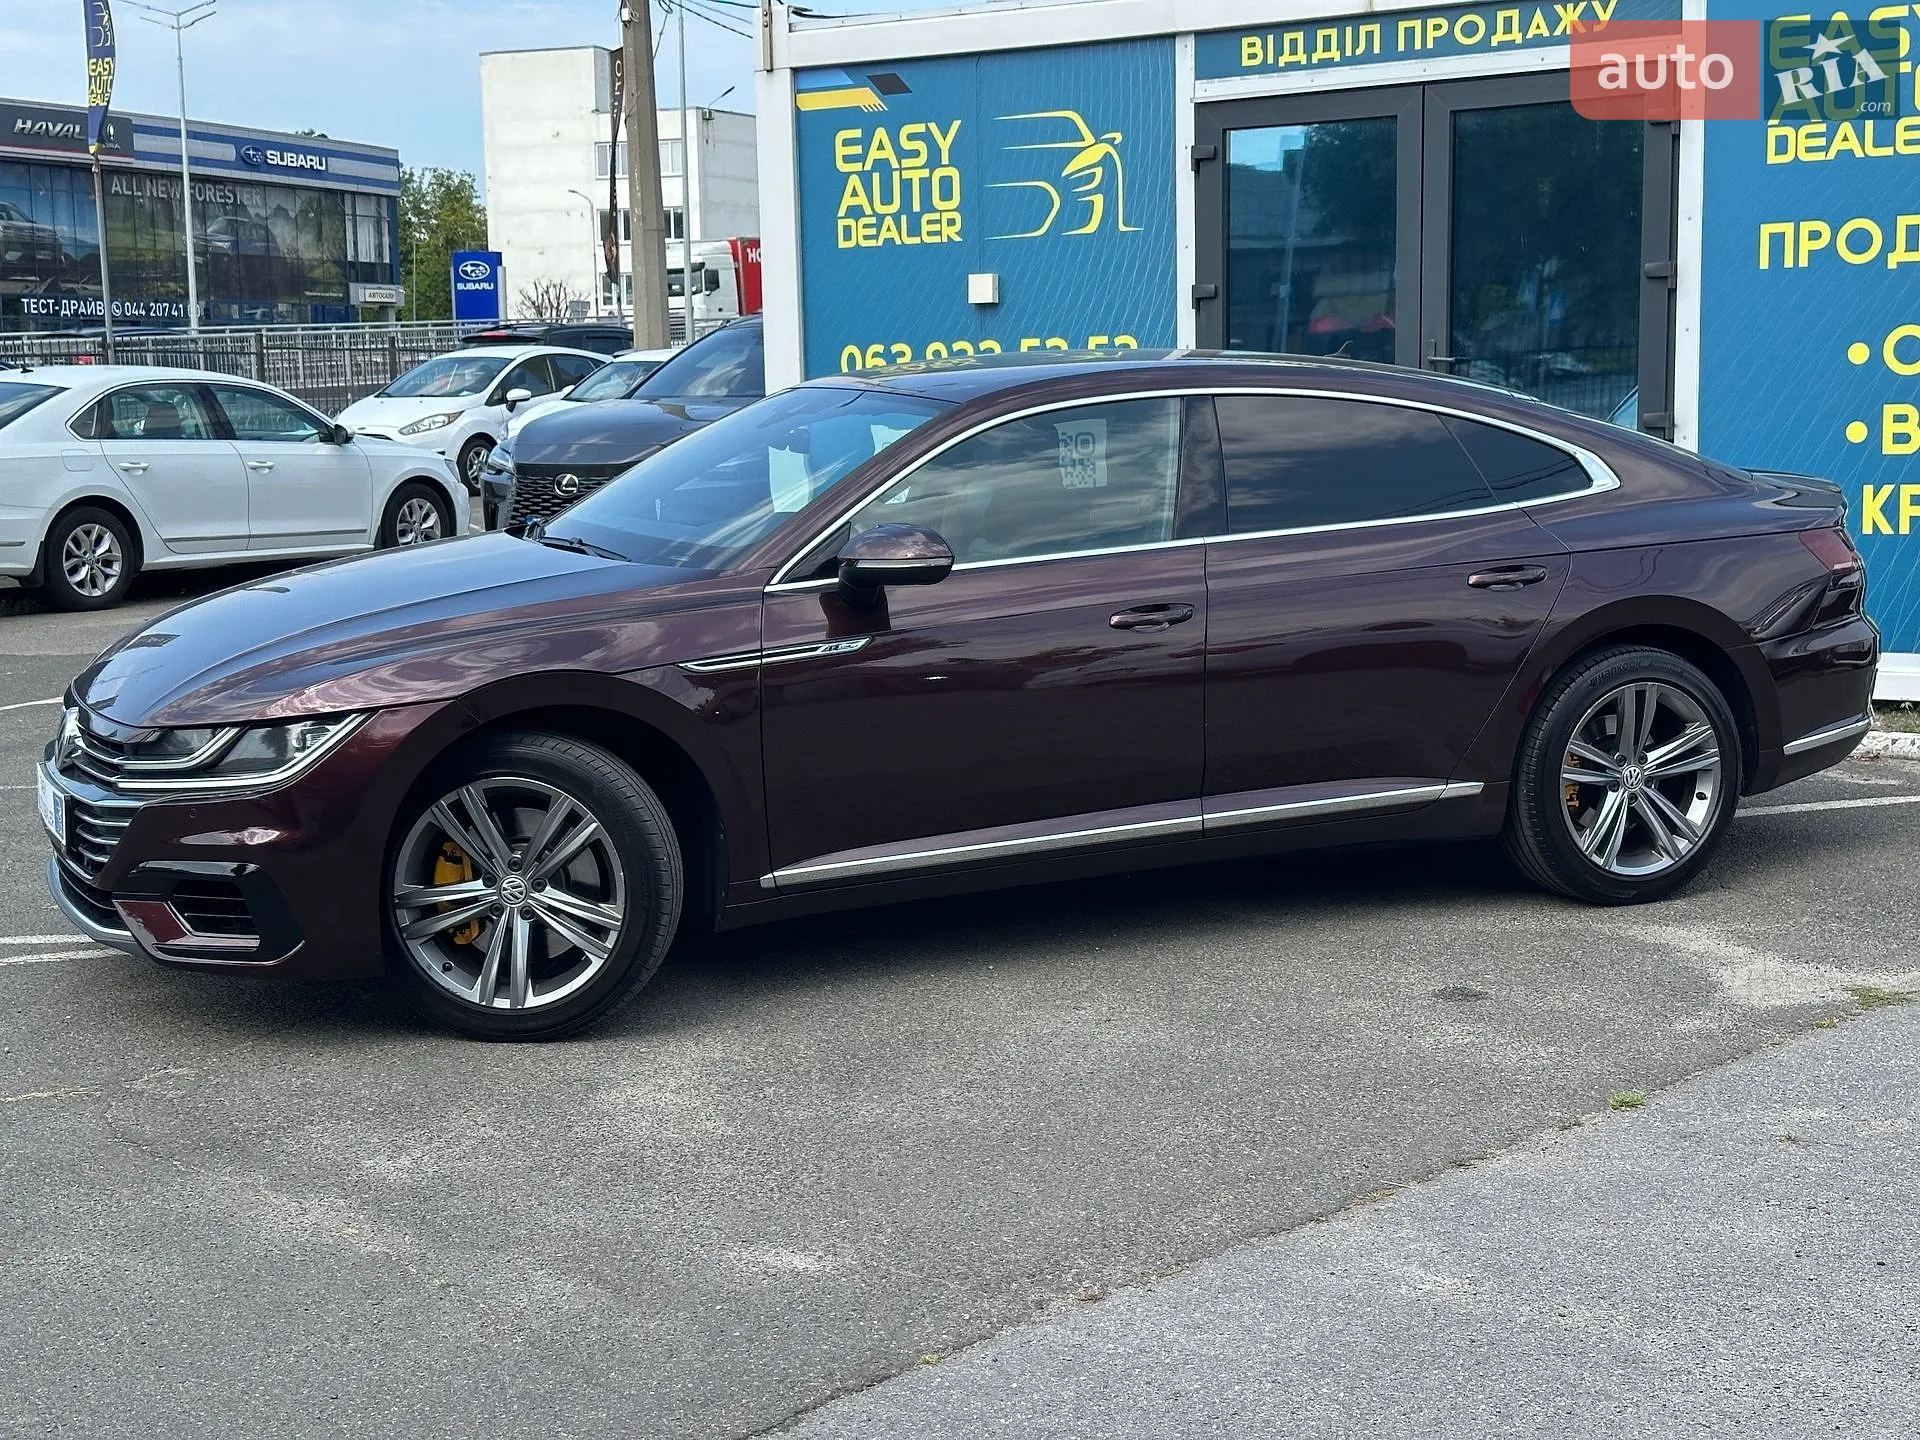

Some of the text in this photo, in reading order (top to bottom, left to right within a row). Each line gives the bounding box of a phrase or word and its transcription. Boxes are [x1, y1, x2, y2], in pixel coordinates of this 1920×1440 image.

[1241, 0, 1618, 67] ВІДДІЛ ПРОДАЖУ
[1769, 5, 1920, 69] EAS
[88, 57, 115, 76] EASY
[1767, 60, 1920, 126] AUT
[12, 118, 87, 140] HAVAL
[266, 150, 326, 170] SUBARU
[835, 120, 961, 172] EASY
[111, 175, 261, 205] ALL NEW FORESTER
[837, 167, 960, 217] AUTO
[838, 211, 962, 248] DEALER
[456, 282, 494, 290] SUBARU
[21, 298, 104, 317] ТЕСТ-ДРАЙВ
[124, 301, 146, 316] 044
[149, 302, 168, 317] 207
[171, 303, 184, 317] 41
